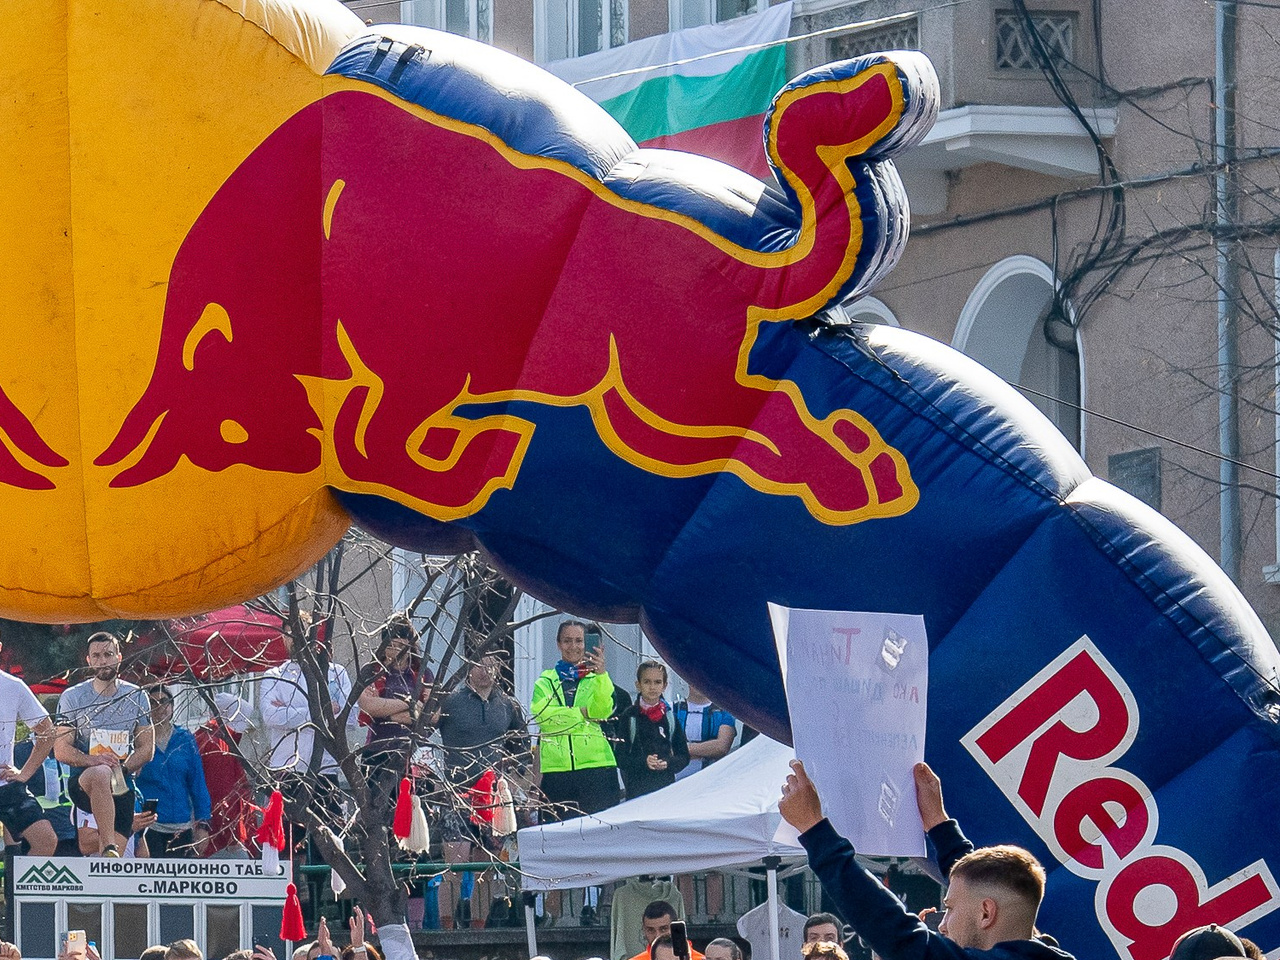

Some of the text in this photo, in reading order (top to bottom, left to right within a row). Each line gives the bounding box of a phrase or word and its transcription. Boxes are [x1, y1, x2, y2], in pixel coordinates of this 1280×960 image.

[90, 862, 284, 877] ИНФОРМАЦИОННО ТАБО
[138, 881, 238, 895] с.МАРКОВО
